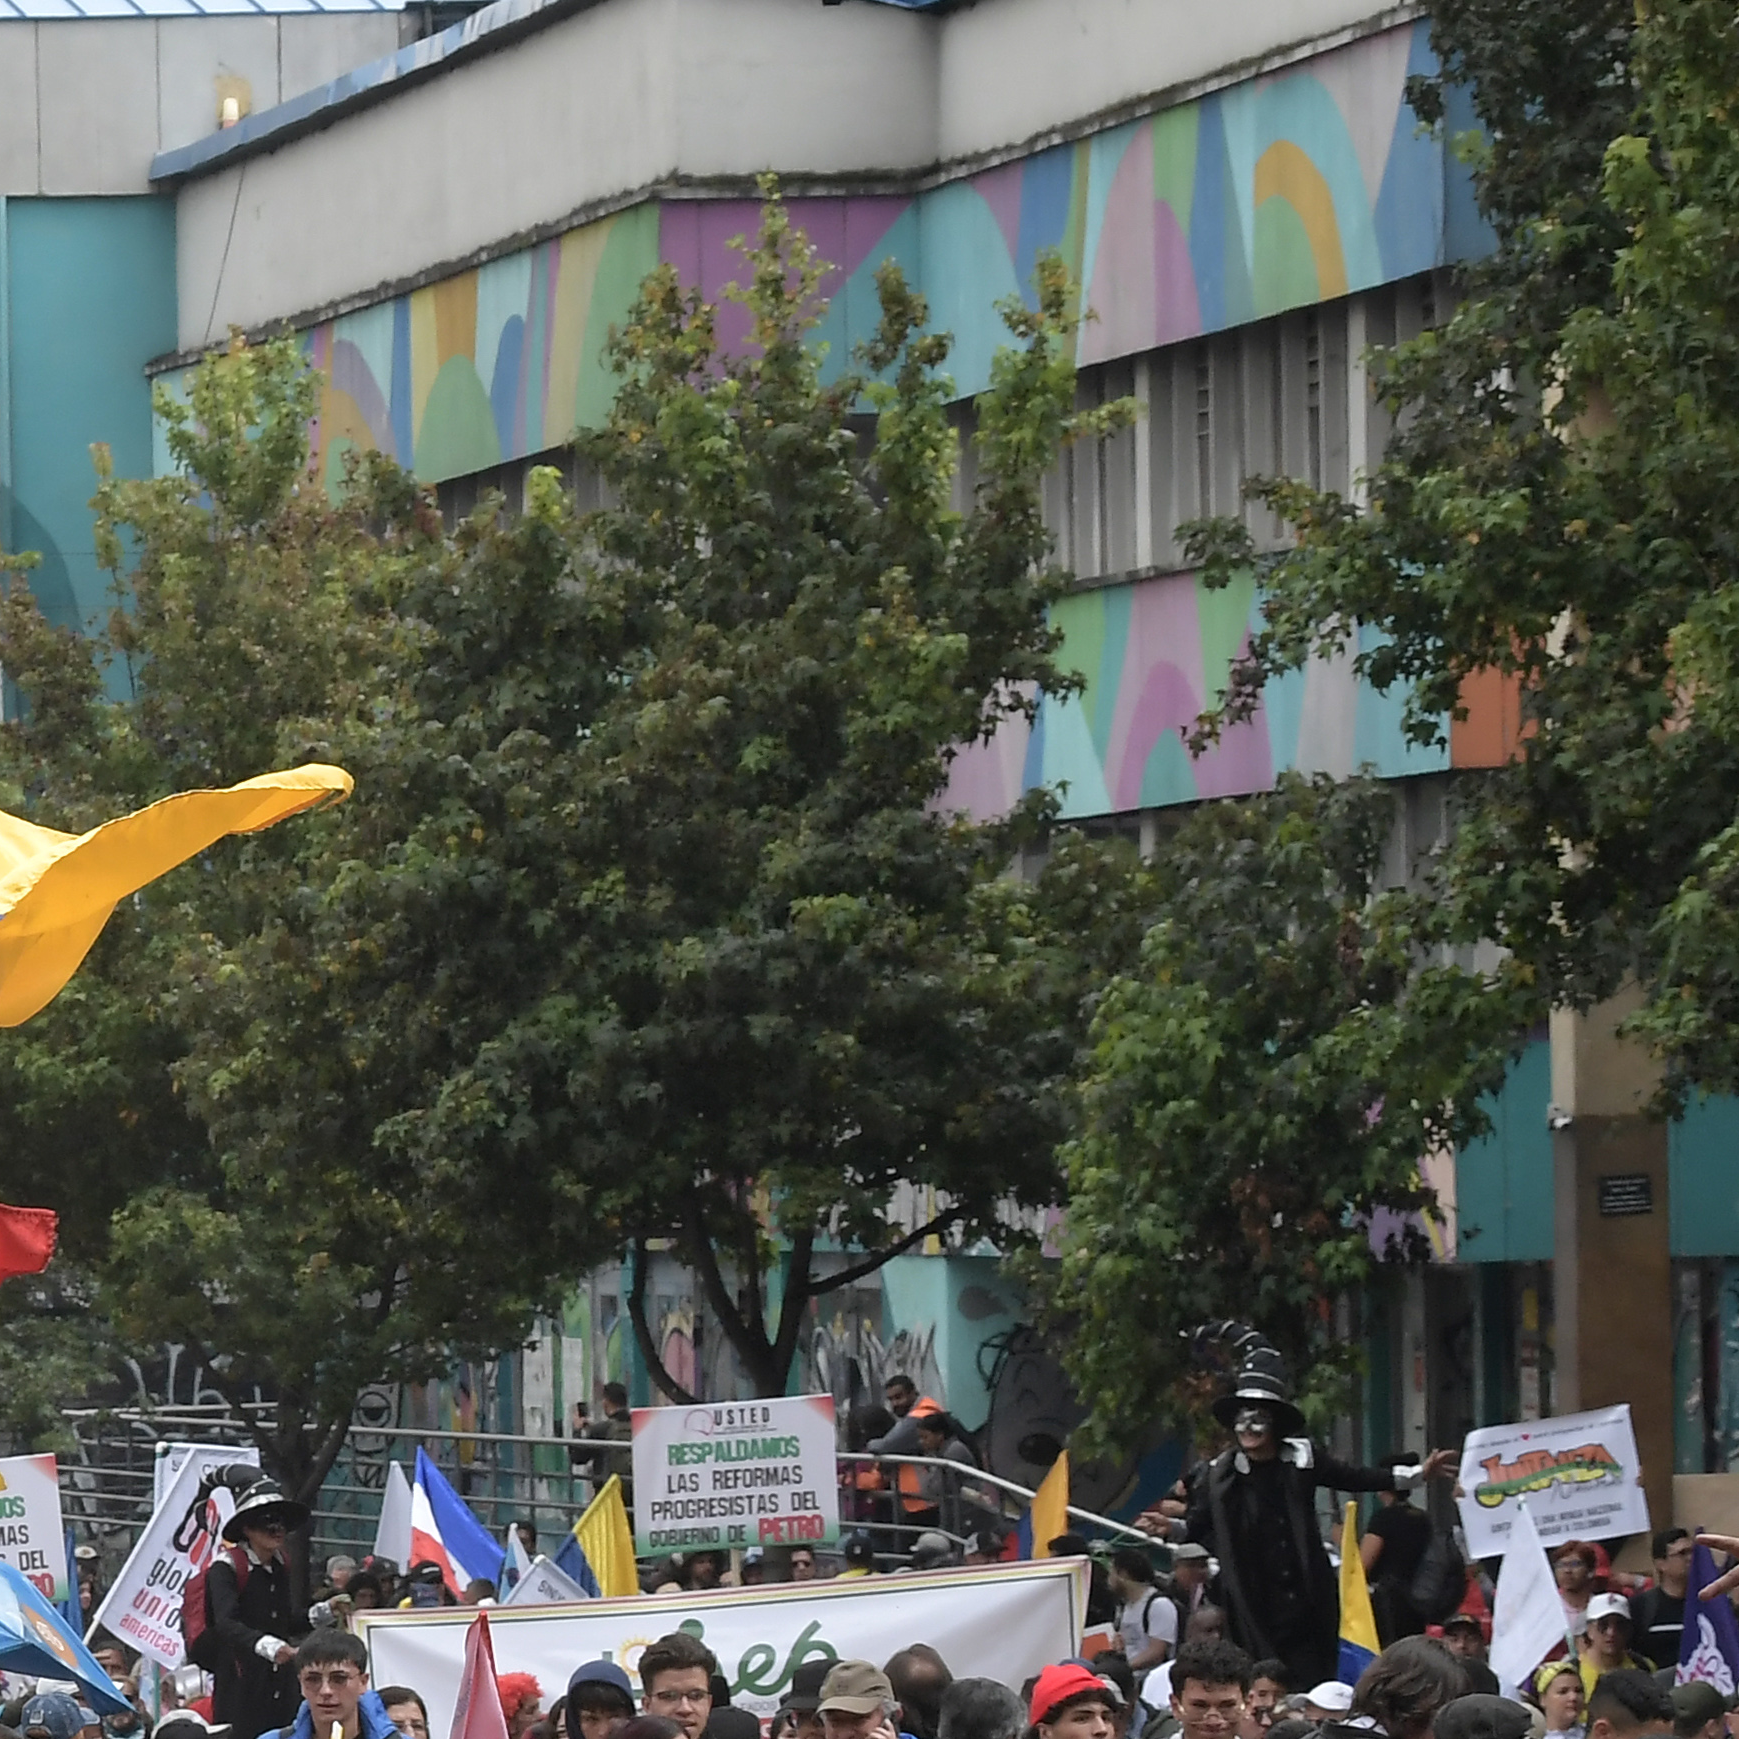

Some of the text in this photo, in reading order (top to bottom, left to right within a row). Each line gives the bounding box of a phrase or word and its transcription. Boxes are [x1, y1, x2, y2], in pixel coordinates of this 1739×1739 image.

[713, 1407, 771, 1426] USTED
[667, 1435, 801, 1467] RESPALDAMOS
[667, 1465, 804, 1494] LAS REFORMAS
[651, 1491, 820, 1521] PROGRESISTAS DEL
[727, 1524, 747, 1543] DE
[758, 1513, 826, 1543] PETRO
